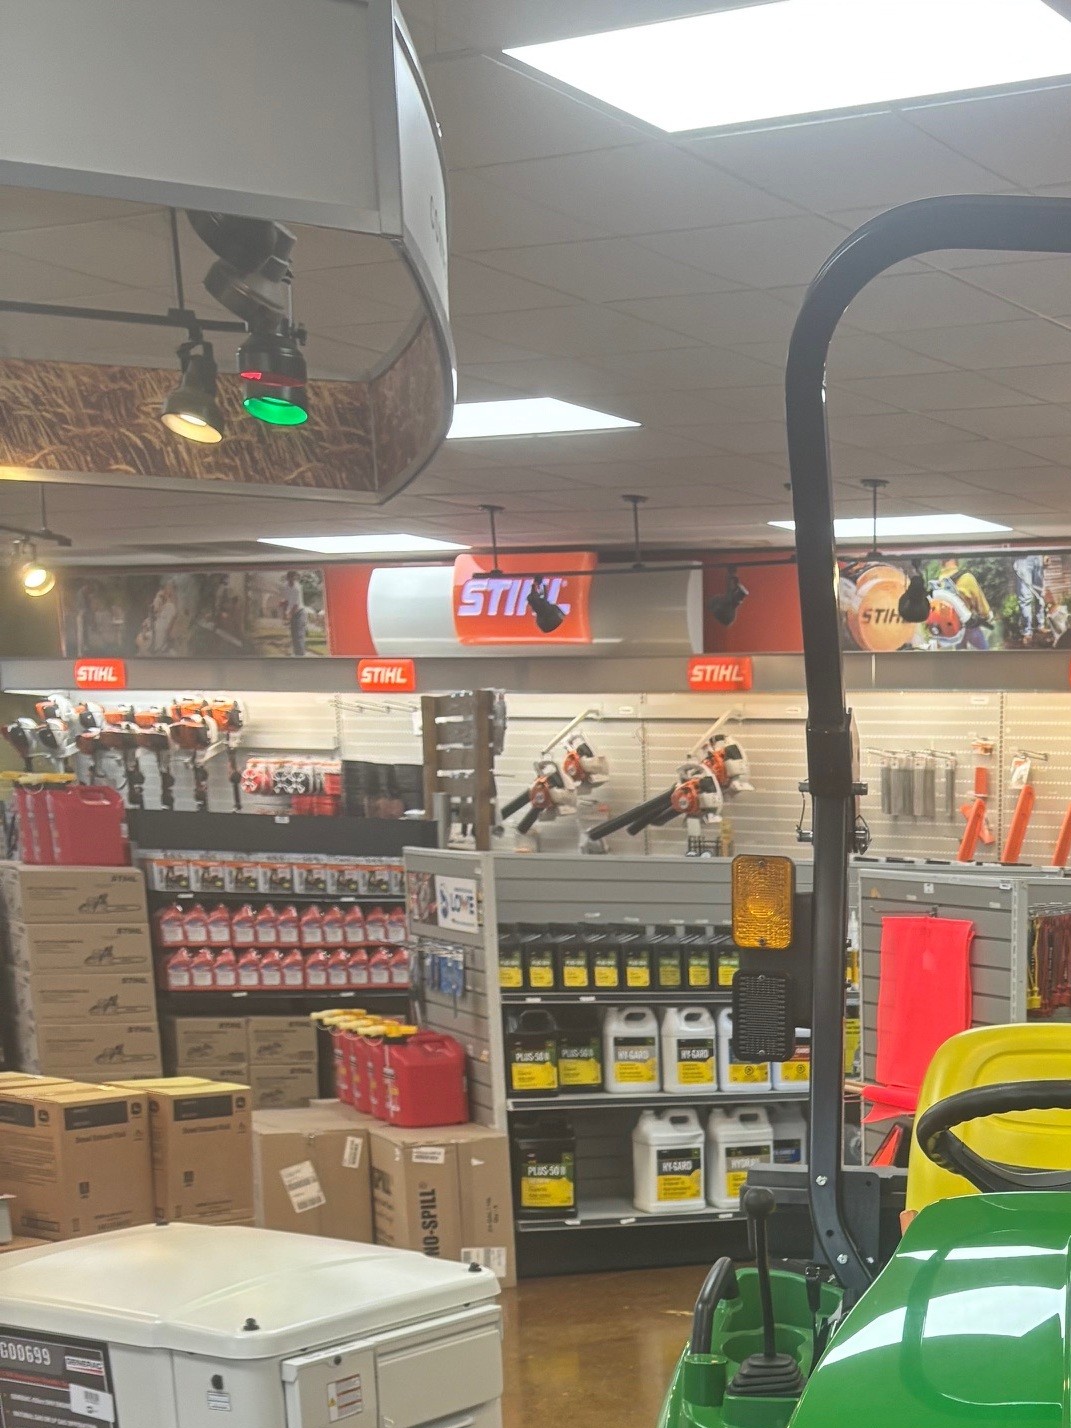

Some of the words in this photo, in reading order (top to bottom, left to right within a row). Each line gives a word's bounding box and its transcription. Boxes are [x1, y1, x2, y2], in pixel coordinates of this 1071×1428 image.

[862, 608, 906, 624] STIH
[77, 666, 118, 682] STIHL
[361, 667, 407, 684] STIHL
[690, 665, 744, 682] STIHL
